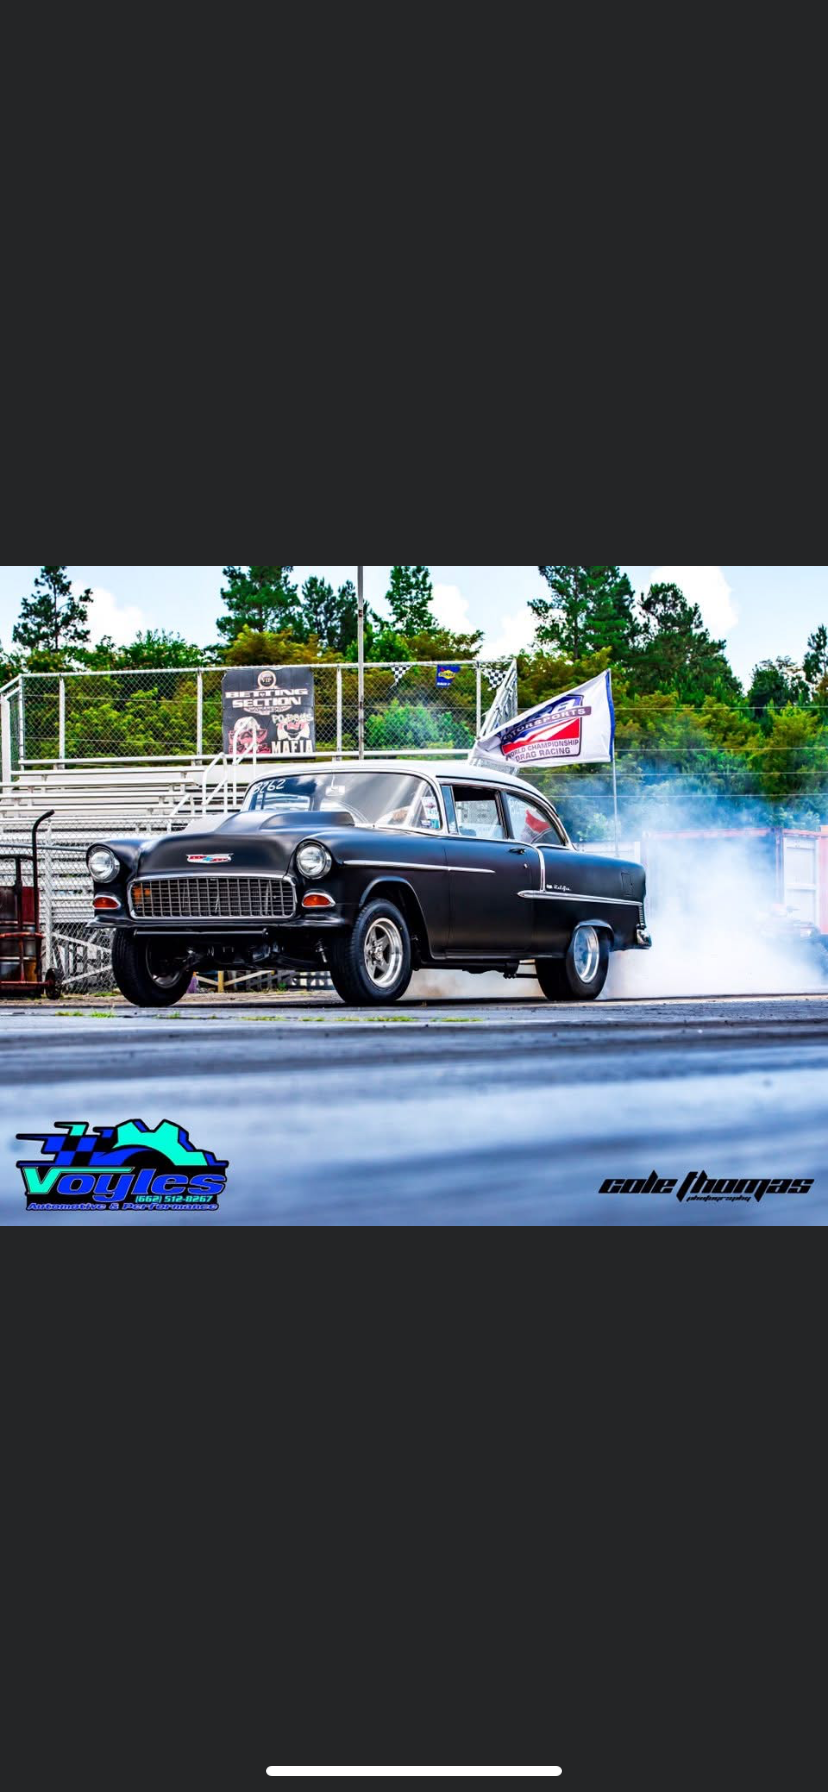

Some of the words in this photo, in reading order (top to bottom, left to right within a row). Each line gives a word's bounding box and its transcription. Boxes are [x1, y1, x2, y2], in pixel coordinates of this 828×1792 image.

[225, 689, 308, 698] BETTING
[232, 697, 301, 708] SECTION
[271, 740, 314, 754] MAFIA
[527, 739, 579, 751] CHAMPIONSHIP
[539, 747, 571, 757] RACING
